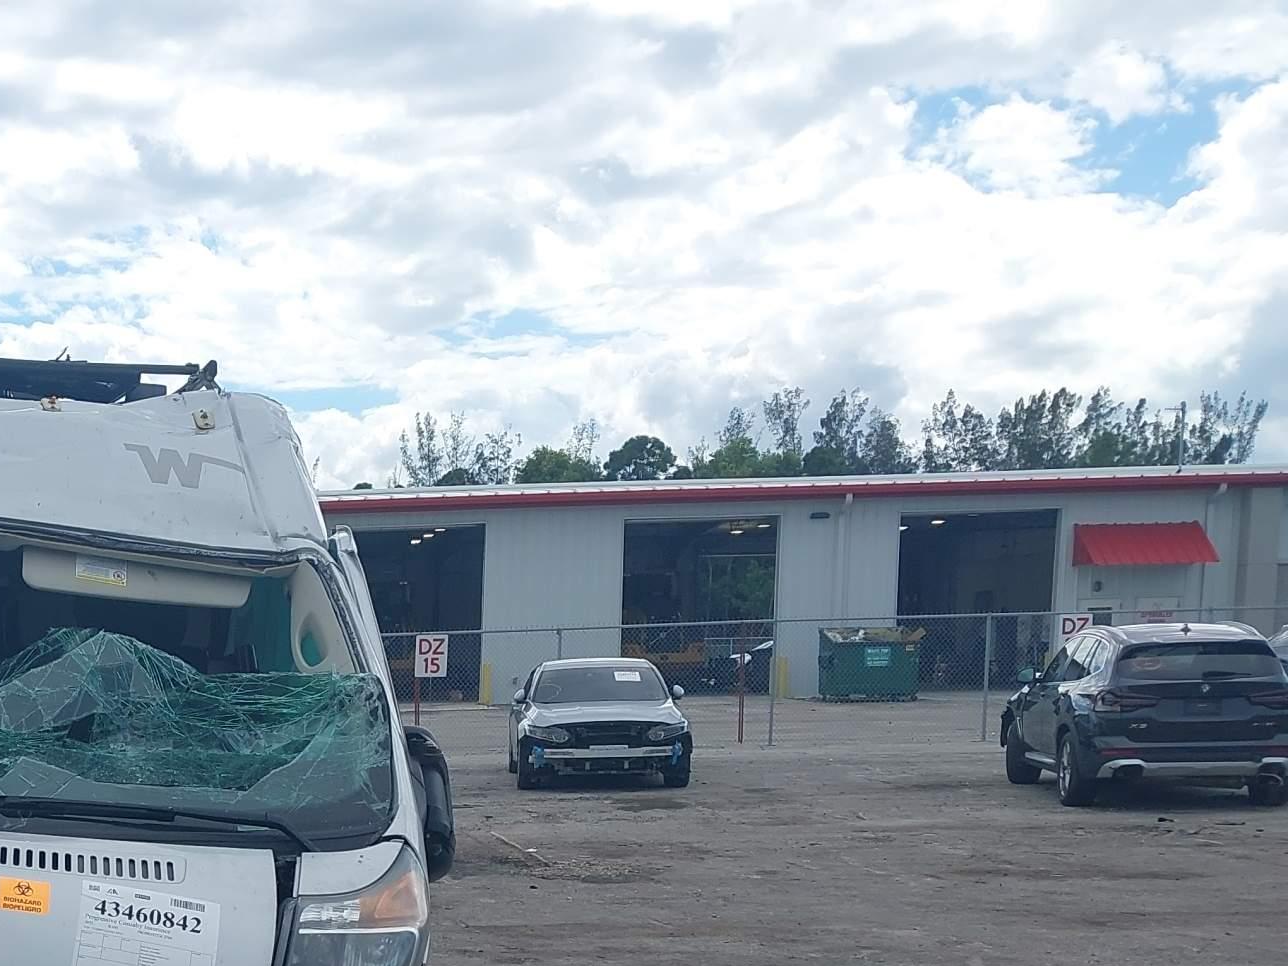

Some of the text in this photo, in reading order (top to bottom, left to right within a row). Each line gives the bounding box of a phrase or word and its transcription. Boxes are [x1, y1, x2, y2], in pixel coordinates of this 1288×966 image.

[1062, 617, 1089, 635] DZ
[418, 638, 445, 655] DZ
[423, 657, 440, 674] 15
[2, 902, 42, 913] BIOPELIGRO
[3, 896, 42, 906] BIOHAZARD
[94, 899, 202, 934] 43460842
